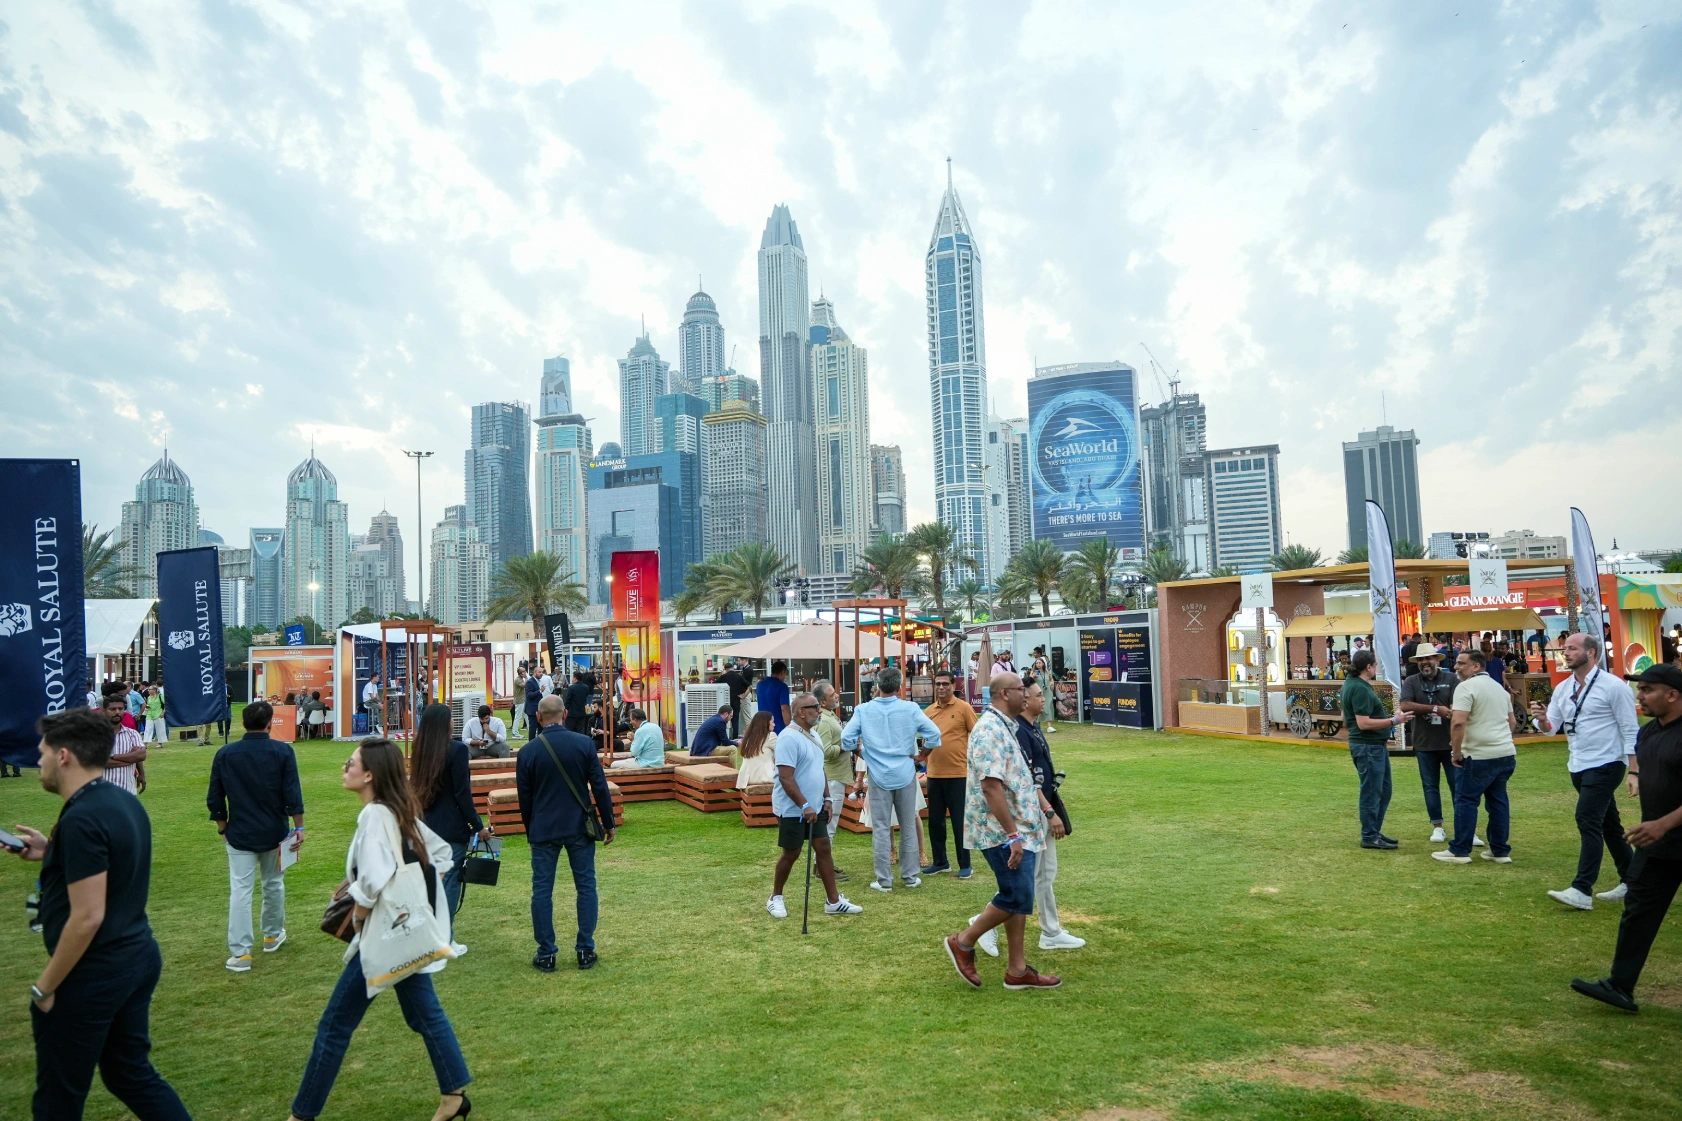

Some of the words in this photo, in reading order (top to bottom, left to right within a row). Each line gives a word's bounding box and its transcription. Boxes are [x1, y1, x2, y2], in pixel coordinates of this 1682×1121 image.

[1044, 439, 1118, 459] SeaWorld
[595, 459, 626, 467] LANDMARK
[1048, 514, 1075, 526] THERE'S
[1076, 513, 1096, 524] MORE
[1097, 512, 1107, 522] TO
[1108, 511, 1122, 521] SEA
[35, 516, 61, 622] SALUTE
[194, 580, 211, 642] SALUTE
[1449, 592, 1524, 608] GLENMORANGIE
[42, 627, 67, 716] ROYAL
[199, 643, 213, 696] ROYAL
[389, 949, 435, 974] GODAWAN
